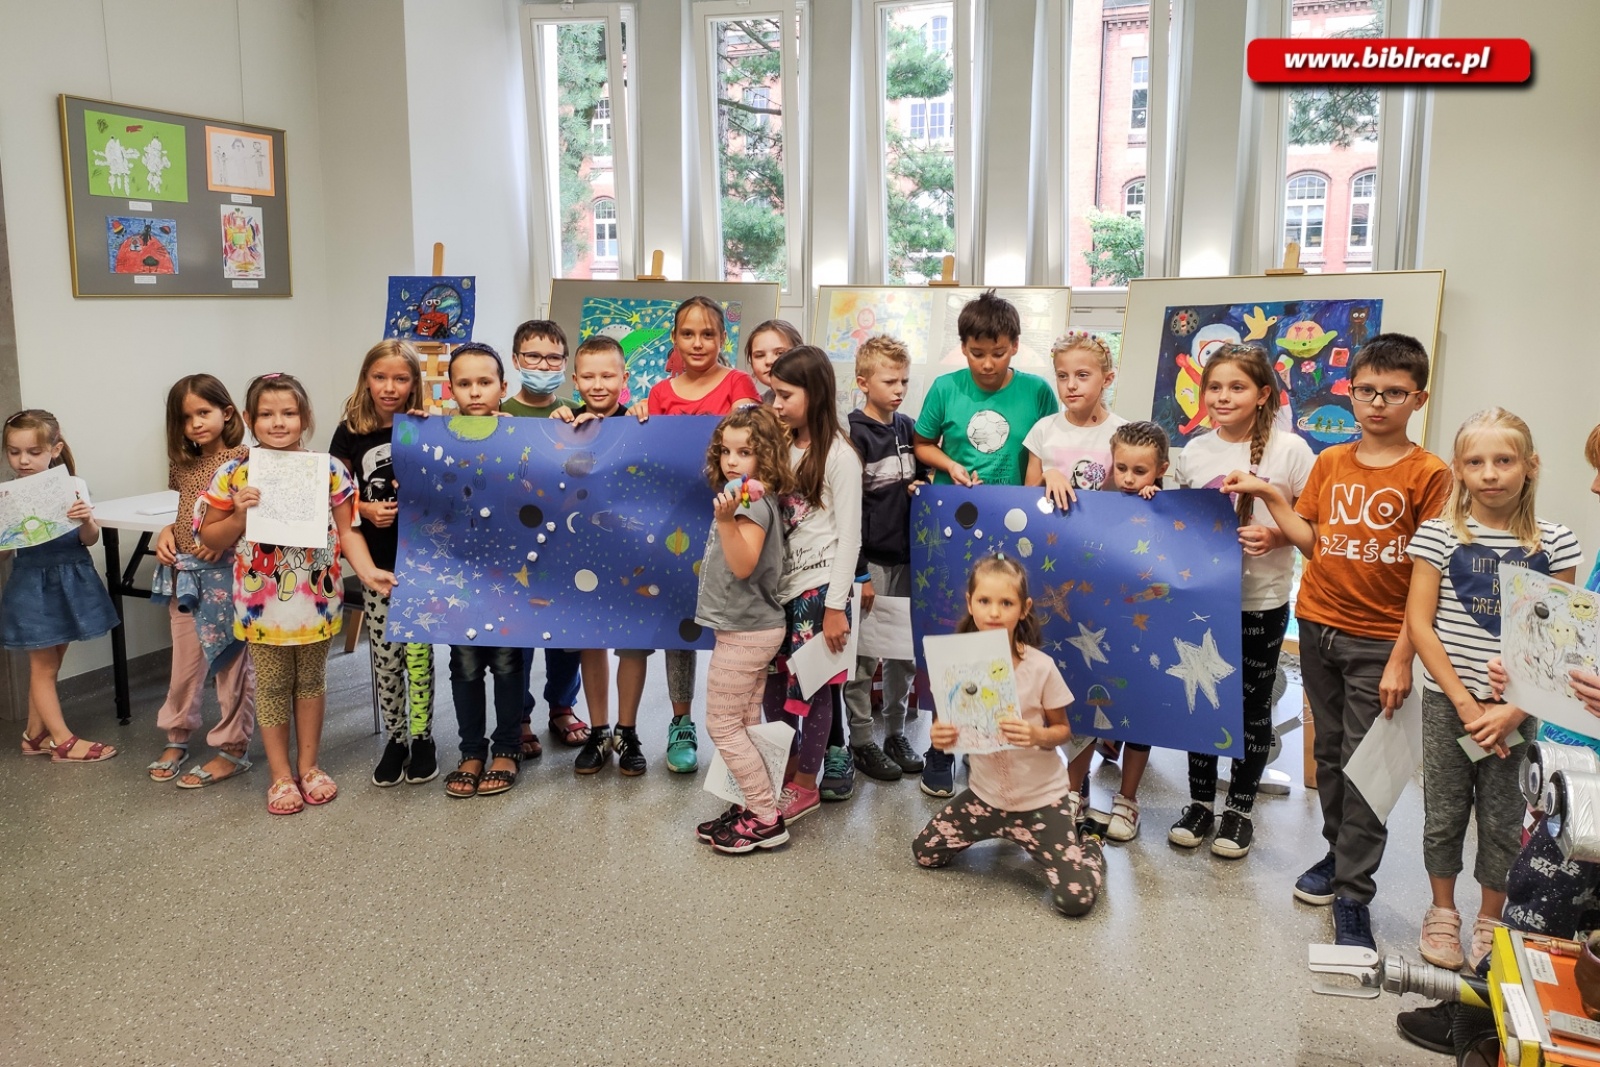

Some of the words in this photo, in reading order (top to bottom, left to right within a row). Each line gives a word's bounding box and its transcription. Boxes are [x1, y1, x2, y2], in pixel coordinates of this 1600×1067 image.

[1329, 483, 1406, 530] NO
[1472, 557, 1505, 575] LITTL
[1472, 596, 1502, 616] DREA
[406, 642, 431, 682] MOUS
